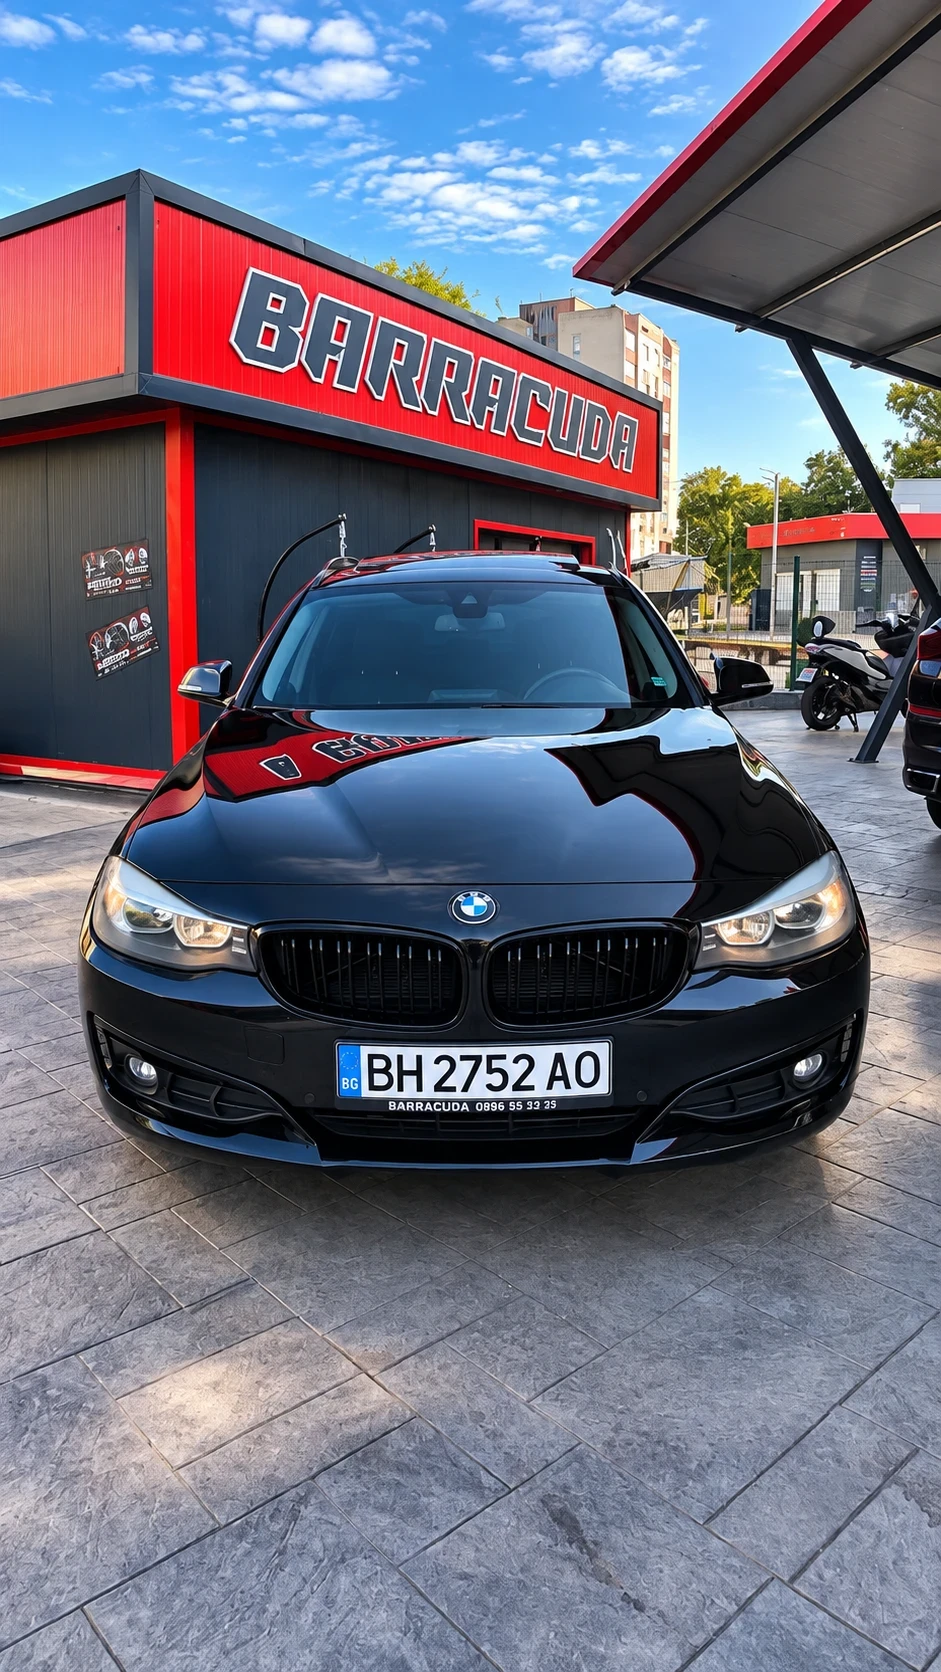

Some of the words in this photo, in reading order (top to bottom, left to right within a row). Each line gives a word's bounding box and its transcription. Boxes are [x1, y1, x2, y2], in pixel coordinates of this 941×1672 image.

[229, 267, 639, 473] BARRACUDA
[341, 1077, 359, 1090] BG
[367, 1053, 423, 1093] BH
[433, 1053, 536, 1093] 2752
[388, 1101, 469, 1112] BARRACUDA
[475, 1101, 505, 1112] 0896
